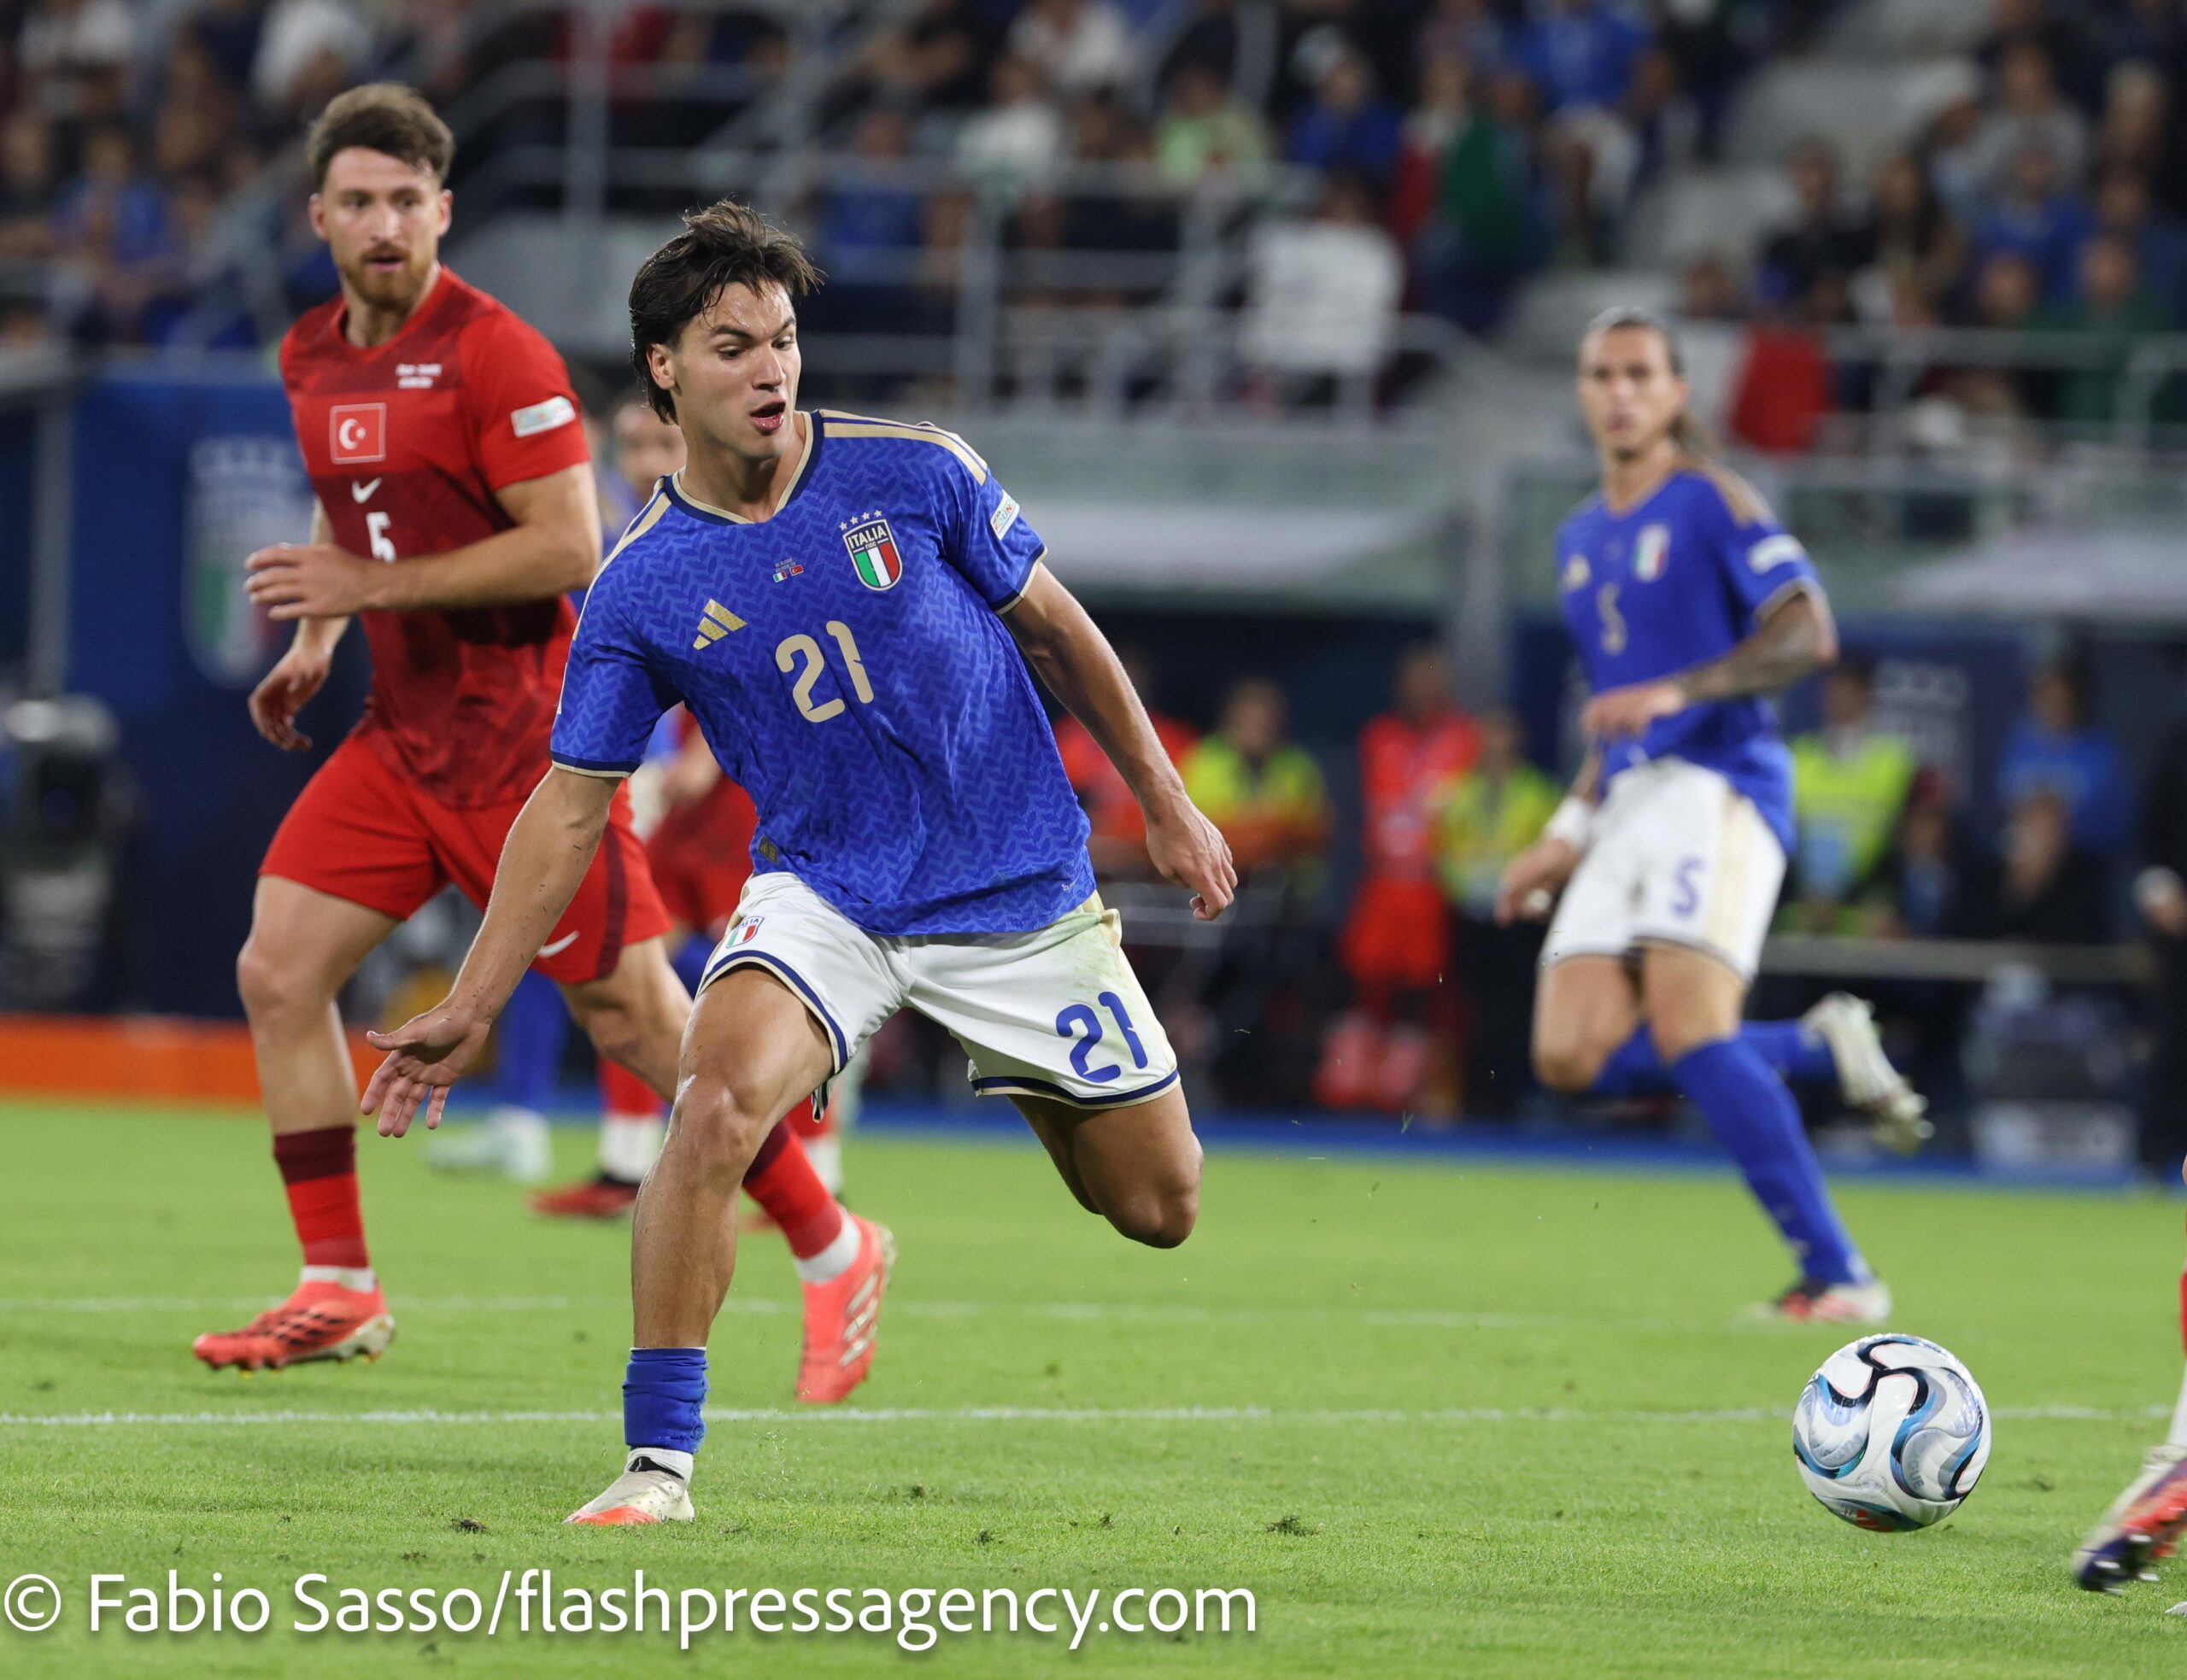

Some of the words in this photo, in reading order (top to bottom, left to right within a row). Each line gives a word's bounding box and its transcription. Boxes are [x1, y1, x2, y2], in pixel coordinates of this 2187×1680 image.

[366, 511, 397, 563] 5
[847, 524, 888, 549] ITALIA
[865, 541, 877, 550] FIGC
[775, 620, 874, 723] 21
[1055, 991, 1148, 1083] 21
